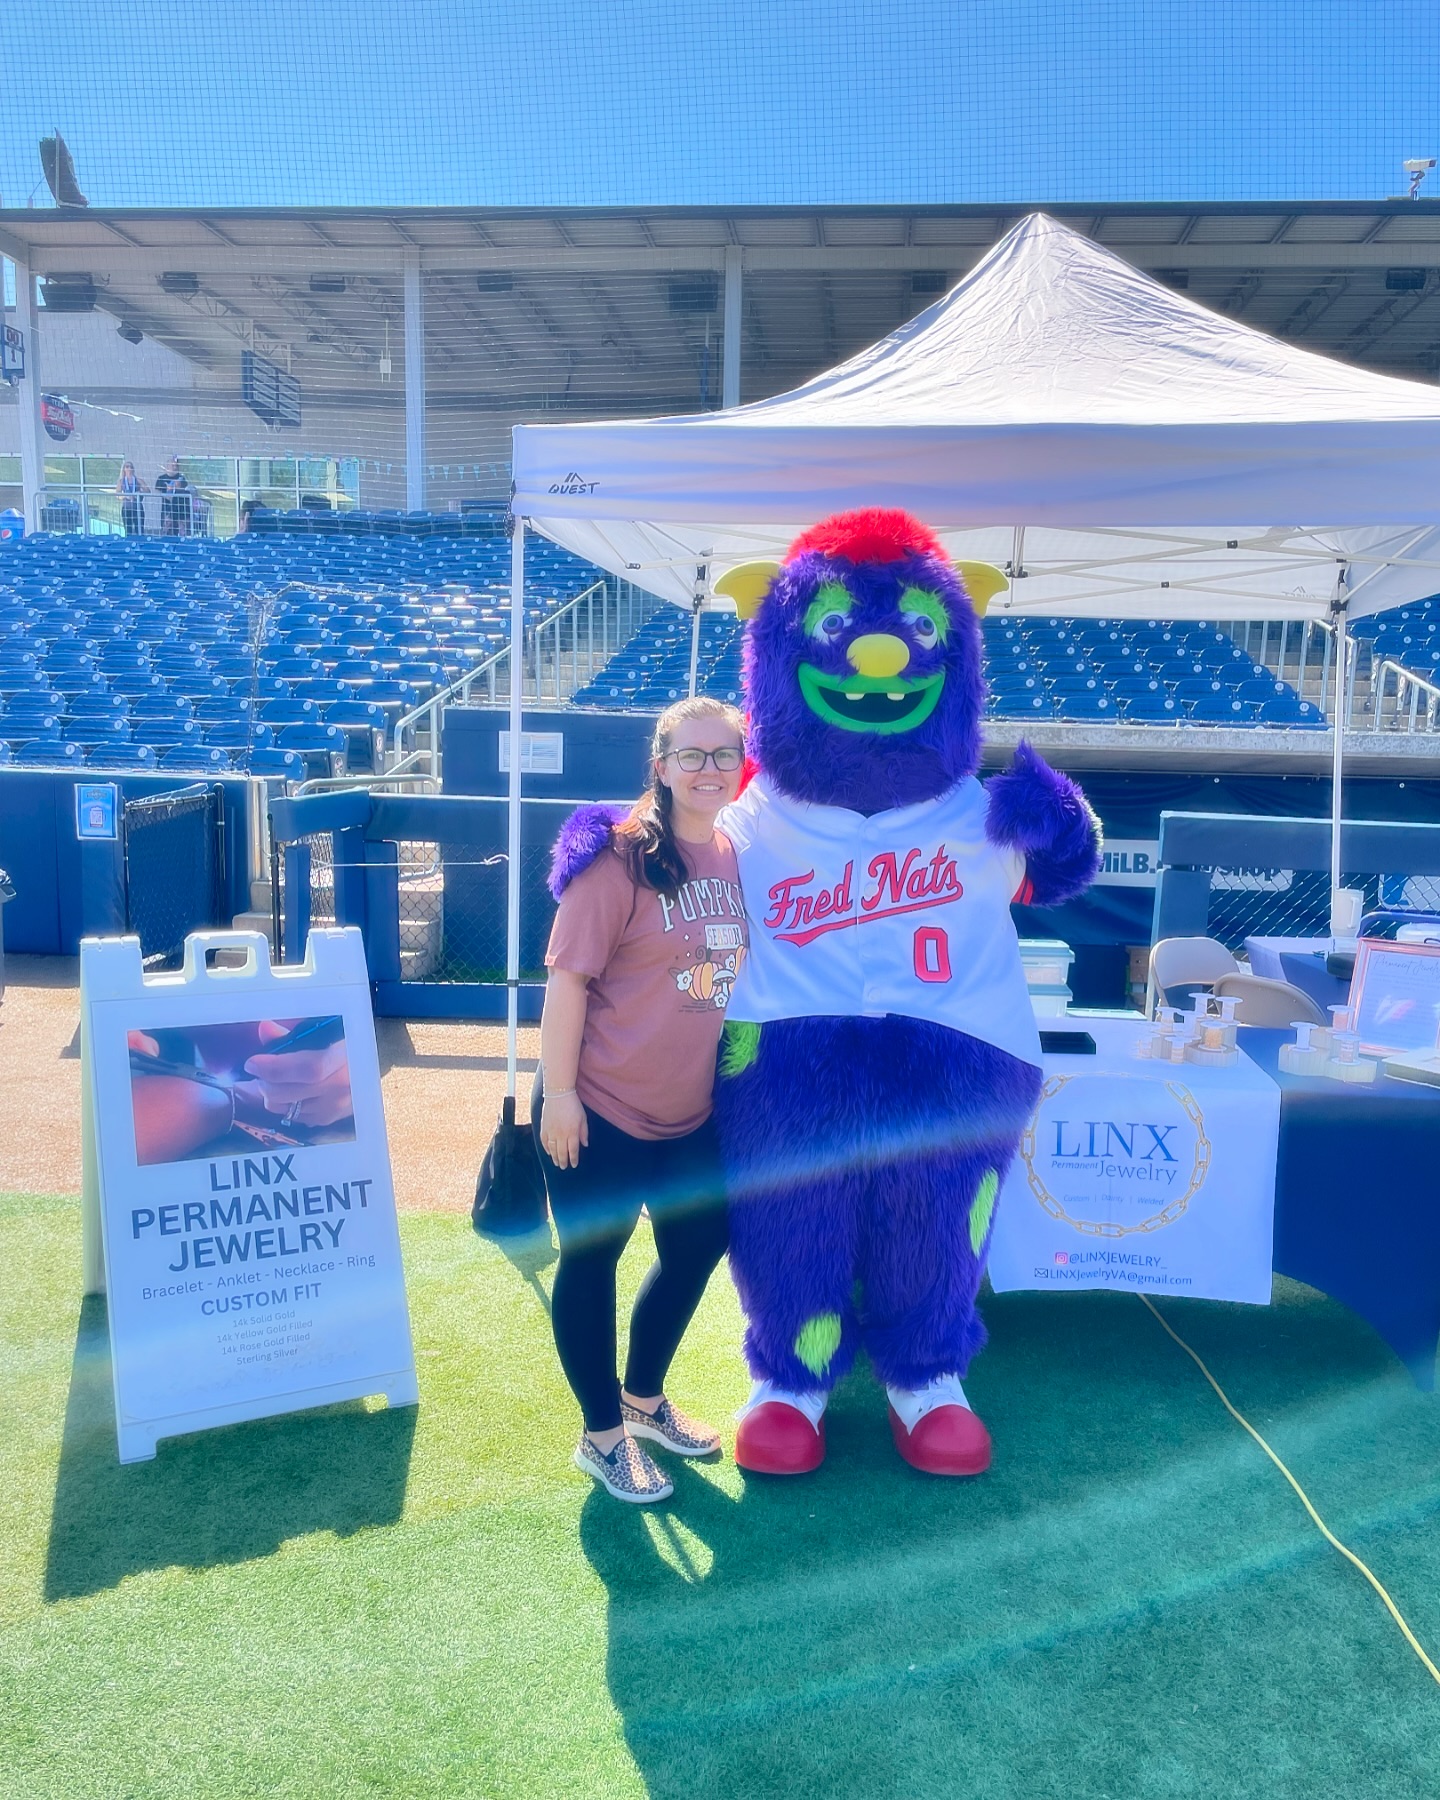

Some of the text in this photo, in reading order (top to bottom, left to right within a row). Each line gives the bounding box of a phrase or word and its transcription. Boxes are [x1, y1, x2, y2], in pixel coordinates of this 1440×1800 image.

[548, 482, 600, 494] QUEST
[763, 844, 963, 929] Fred Nats
[706, 927, 742, 946] SEASON
[913, 926, 953, 983] 0
[1051, 1120, 1179, 1162] LINX
[209, 1153, 298, 1192] LINX
[1051, 1160, 1177, 1185] Permanent Jewelry
[131, 1179, 373, 1240] PERMANENT
[1063, 1194, 1090, 1202] Custom
[1137, 1196, 1164, 1206] Welded
[168, 1218, 346, 1272] JEWELRY
[142, 1280, 204, 1300] Bracelet
[217, 1271, 262, 1289] Anklet
[274, 1259, 335, 1279] Necklace
[347, 1254, 376, 1268] Ring
[1050, 1268, 1192, 1285] LINXJewelryVA@gmail.com
[201, 1282, 322, 1316] CUSTOM FIT
[217, 1319, 313, 1343] 14k Yellow Gold Filled
[233, 1310, 296, 1328] 14k Solid Gold
[222, 1332, 311, 1355] 14k Rose Gold Filled
[236, 1347, 299, 1365] Sterling Silver
